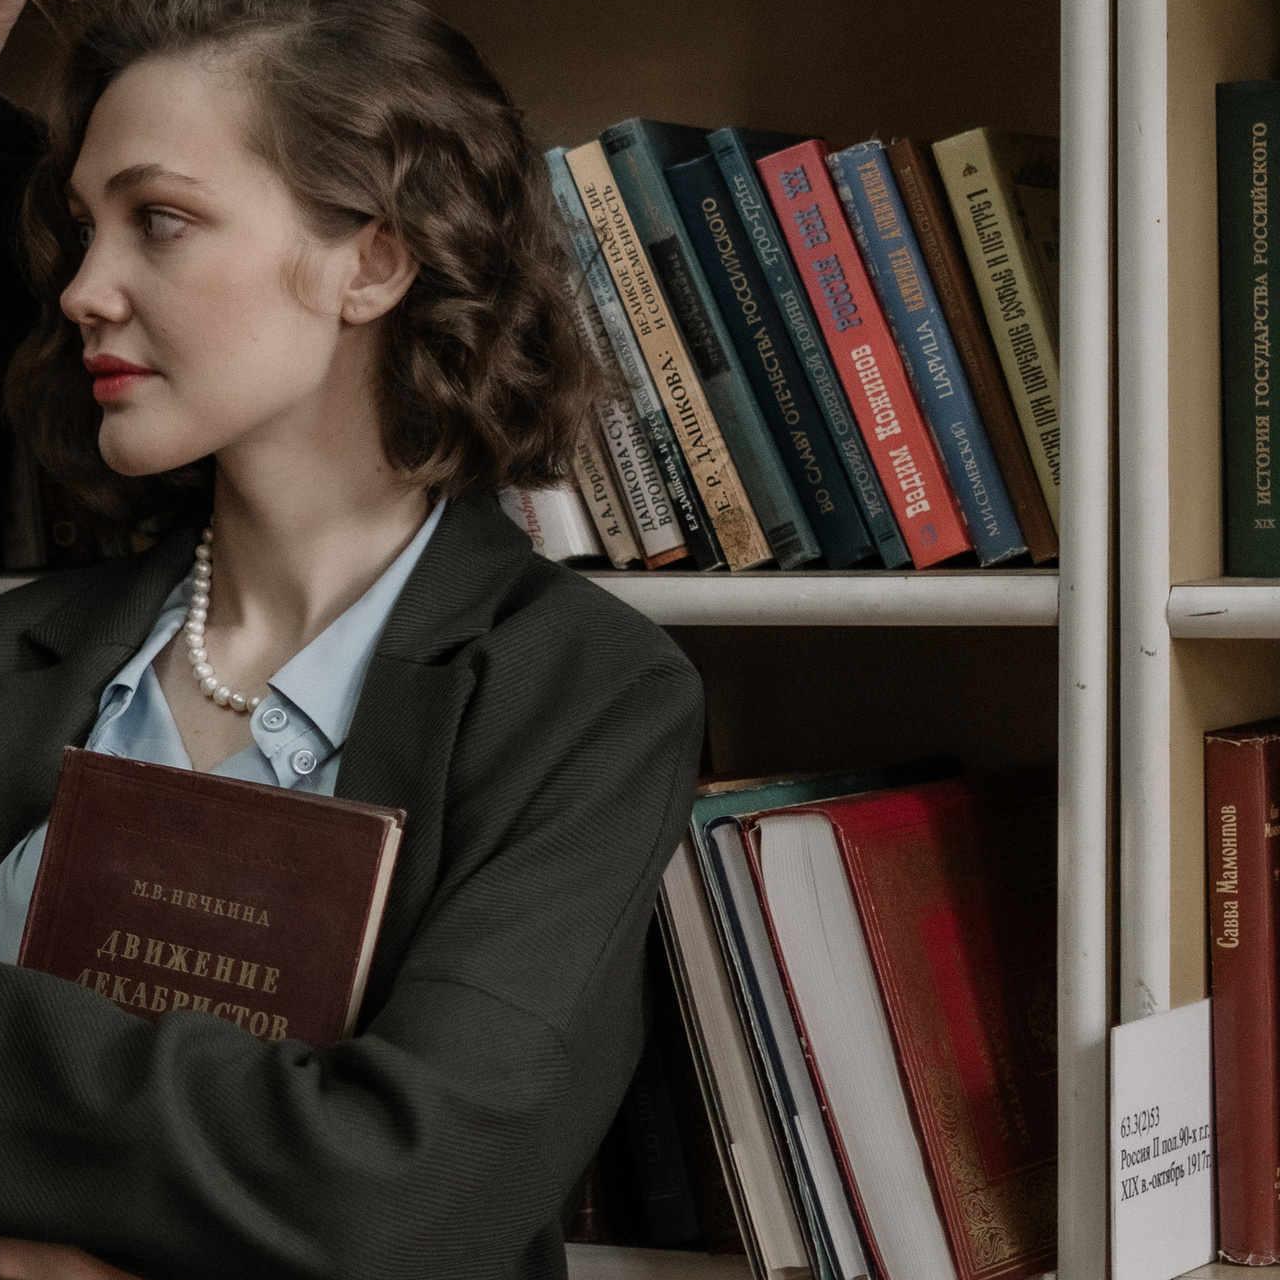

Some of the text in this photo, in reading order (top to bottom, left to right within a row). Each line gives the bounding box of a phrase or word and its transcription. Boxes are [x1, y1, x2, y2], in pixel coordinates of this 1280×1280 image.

[582, 181, 651, 336] ВЕЛИКОЕ НАСЛЕДИЕ
[600, 183, 666, 329] И СОВРЕМЕННОСТЬ
[1249, 122, 1271, 506] ИСТОРИЯ ГОСУДАРСТВА РОССИЙСКОГО
[697, 195, 834, 513] ВО СЛАВУ ОТЕЧЕСТВА РОССИЙСКОГО
[654, 348, 731, 511] Е. Р. ДАШКОВА:
[1254, 518, 1277, 530] XIX
[1216, 805, 1239, 948] Савва Мамонтов
[97, 929, 282, 995] ДВИЖЕНИЕ
[1120, 1105, 1160, 1140] 63.3(2)53
[1120, 1148, 1151, 1171] Россия
[1152, 1136, 1160, 1159] II
[1120, 1174, 1140, 1202] XIX
